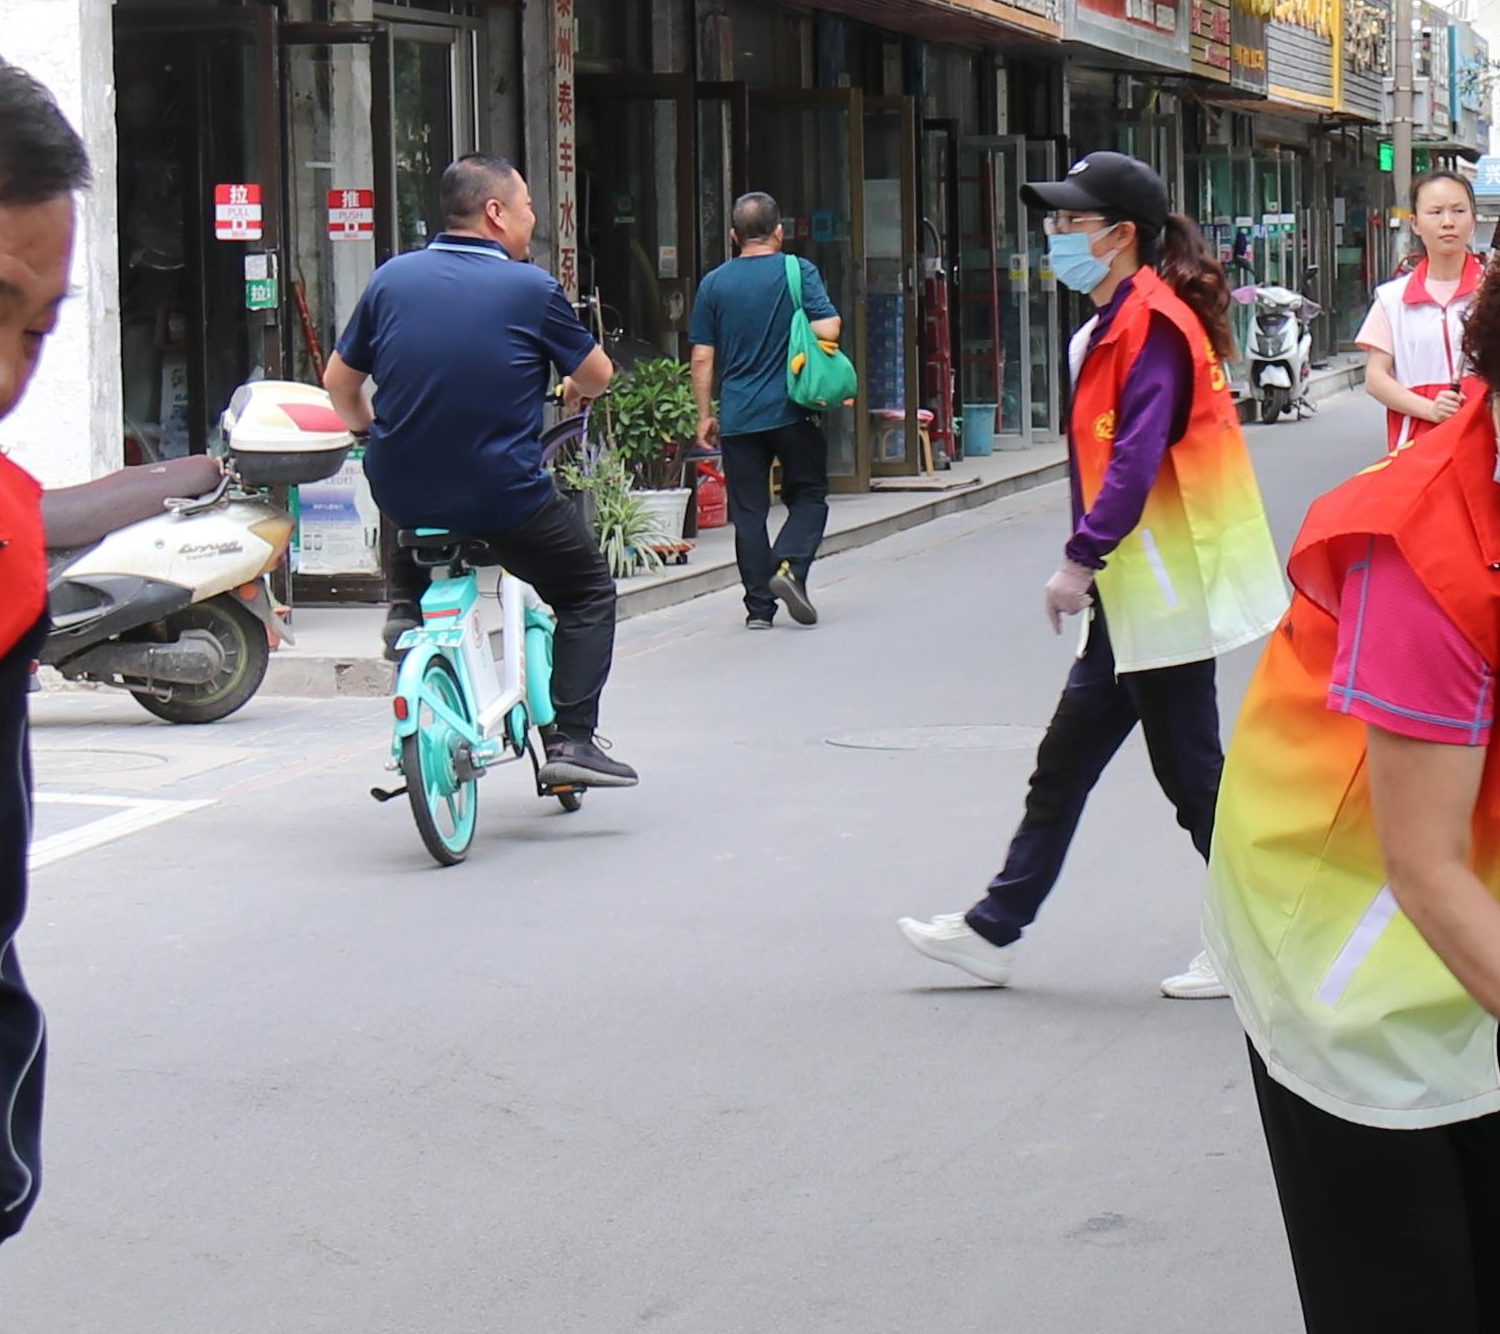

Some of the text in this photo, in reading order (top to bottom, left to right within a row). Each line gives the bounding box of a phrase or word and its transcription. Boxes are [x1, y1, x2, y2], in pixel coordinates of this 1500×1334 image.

[230, 185, 249, 205] 拉
[342, 190, 360, 208] 推
[227, 207, 249, 217] PULL
[338, 211, 364, 220] PUSH
